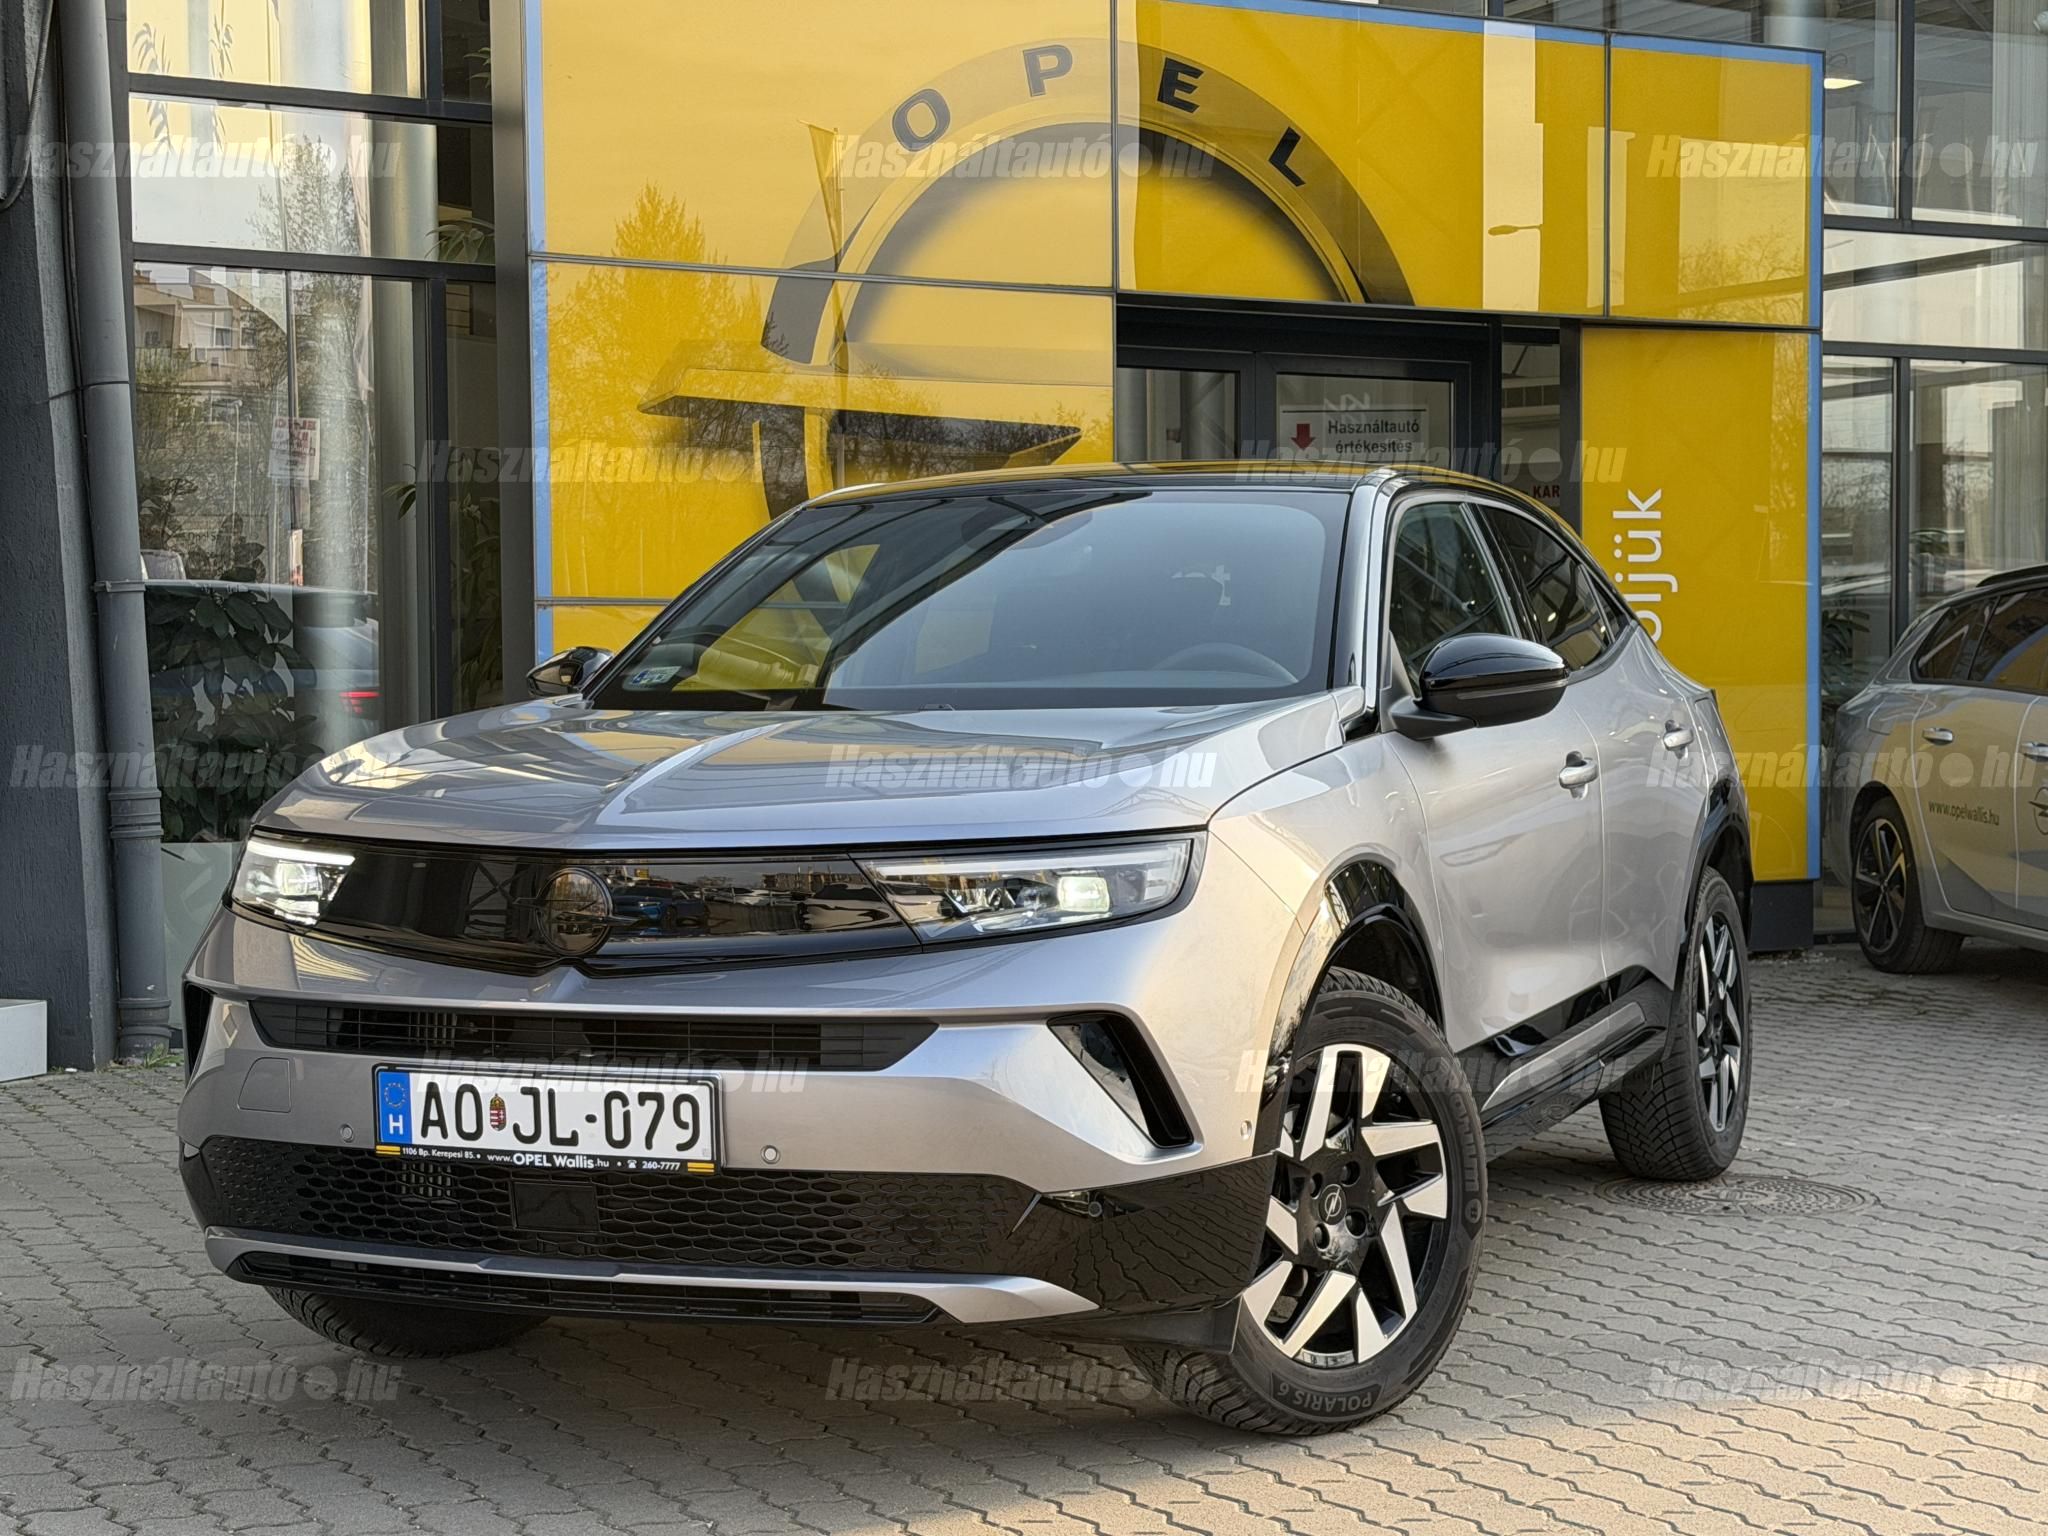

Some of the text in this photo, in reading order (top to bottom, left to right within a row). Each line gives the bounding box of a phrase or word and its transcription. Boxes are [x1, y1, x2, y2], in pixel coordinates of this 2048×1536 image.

[891, 44, 1307, 188] OPEL
[1327, 417, 1421, 435] Használtautó
[1533, 484, 1561, 499] KAR
[1928, 800, 2000, 827] www.opelwallis.hu
[420, 1081, 484, 1142] AO
[388, 1113, 404, 1136] H
[402, 1147, 418, 1156] 1106
[418, 1148, 431, 1158] Bp.
[431, 1149, 463, 1160] Kerepesi
[642, 1160, 681, 1171] 260-7777
[1277, 1382, 1372, 1413] POLARIS 6
